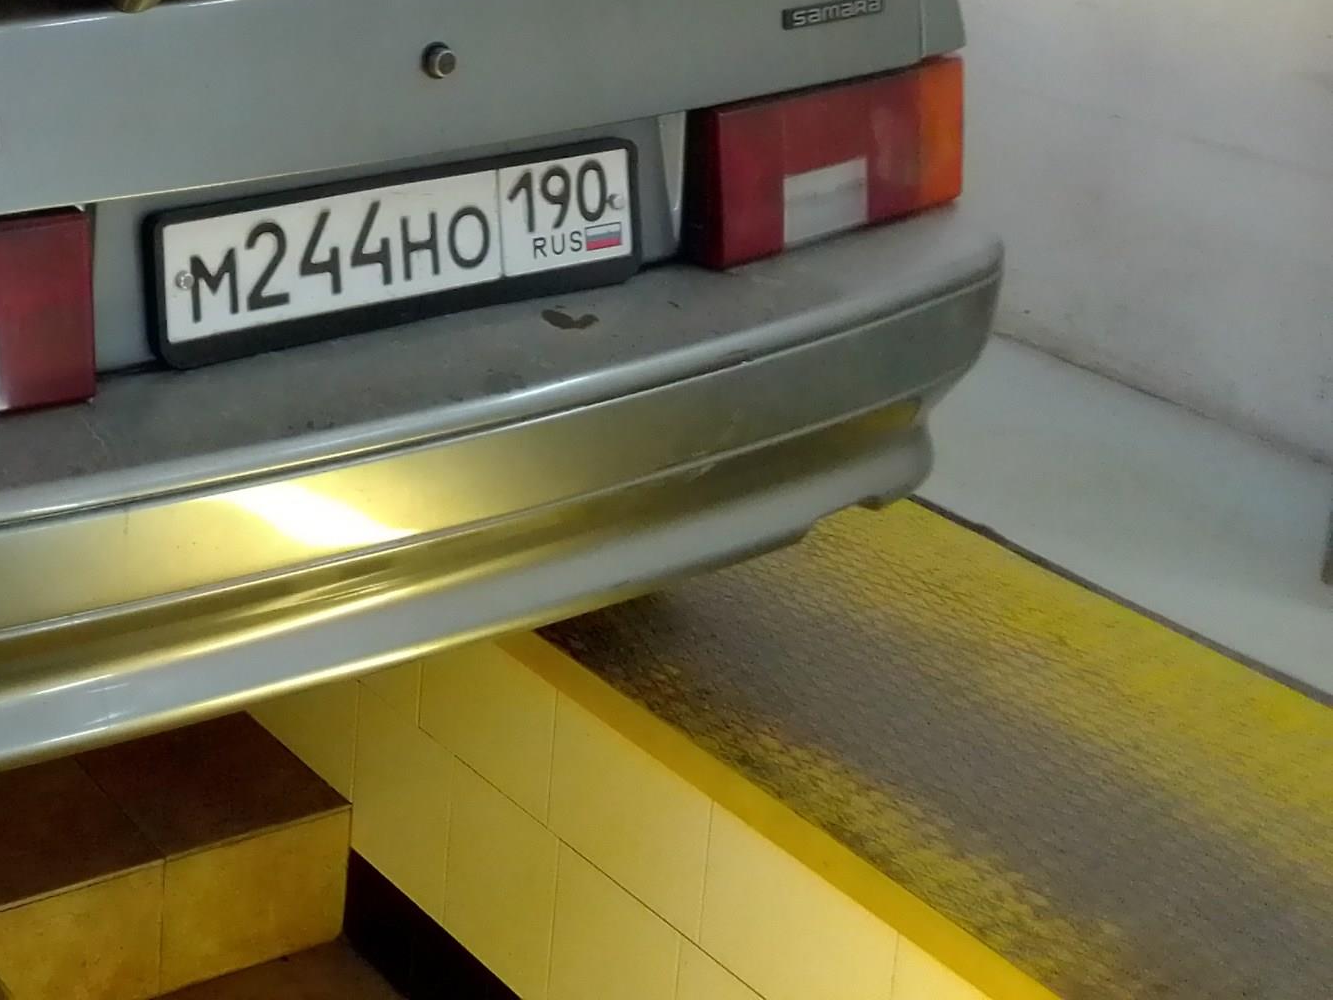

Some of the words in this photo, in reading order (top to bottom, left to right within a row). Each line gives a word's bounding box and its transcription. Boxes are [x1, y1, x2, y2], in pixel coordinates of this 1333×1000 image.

[507, 159, 608, 233] 190
[189, 200, 490, 323] М244НО
[533, 230, 583, 258] RUS
